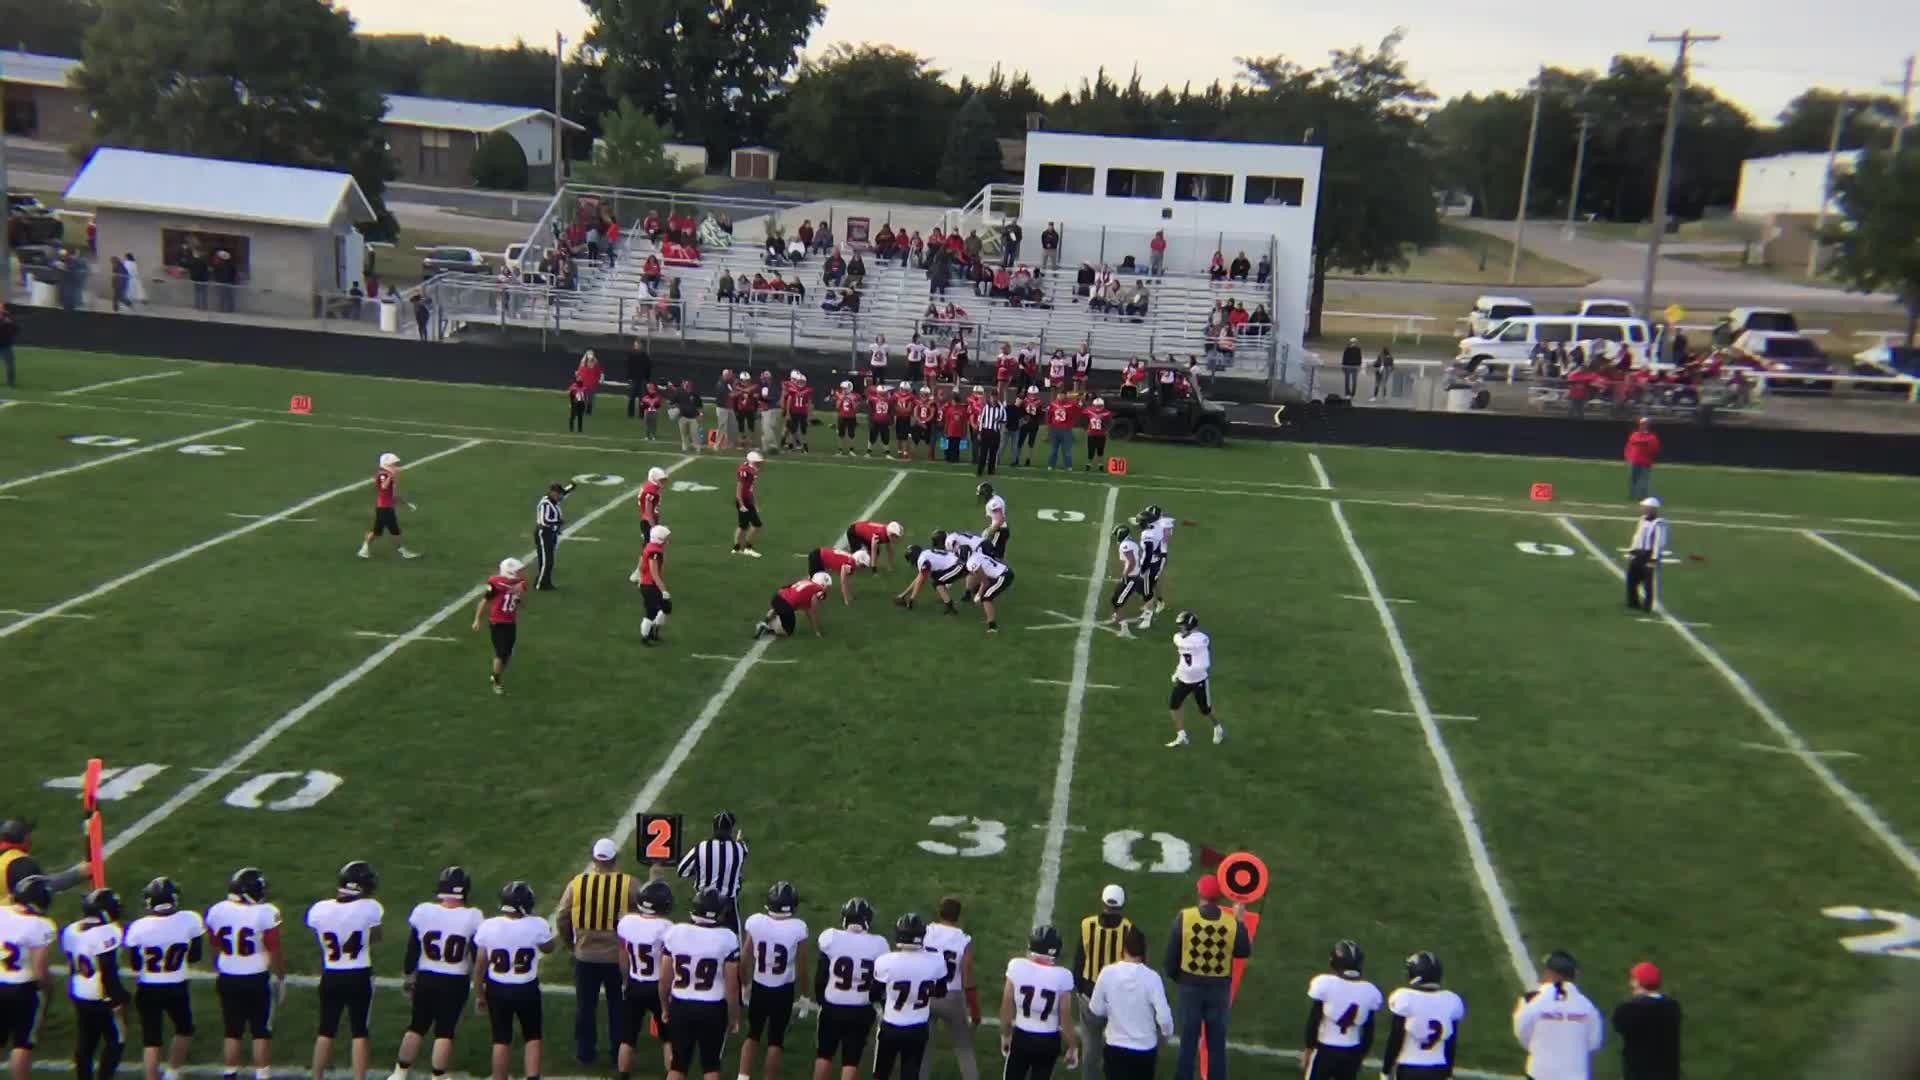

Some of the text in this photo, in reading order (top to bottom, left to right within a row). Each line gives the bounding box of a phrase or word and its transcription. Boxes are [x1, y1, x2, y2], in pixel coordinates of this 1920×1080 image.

[223, 769, 345, 811] 0
[646, 818, 672, 858] 2
[916, 815, 1193, 874] 3 0
[144, 942, 189, 973] 20
[323, 930, 364, 962] 34
[422, 930, 467, 964] 60
[627, 943, 654, 977] 15
[757, 941, 789, 976] 13
[674, 954, 719, 992] 59
[833, 955, 874, 992] 93
[1019, 984, 1057, 1022] 77
